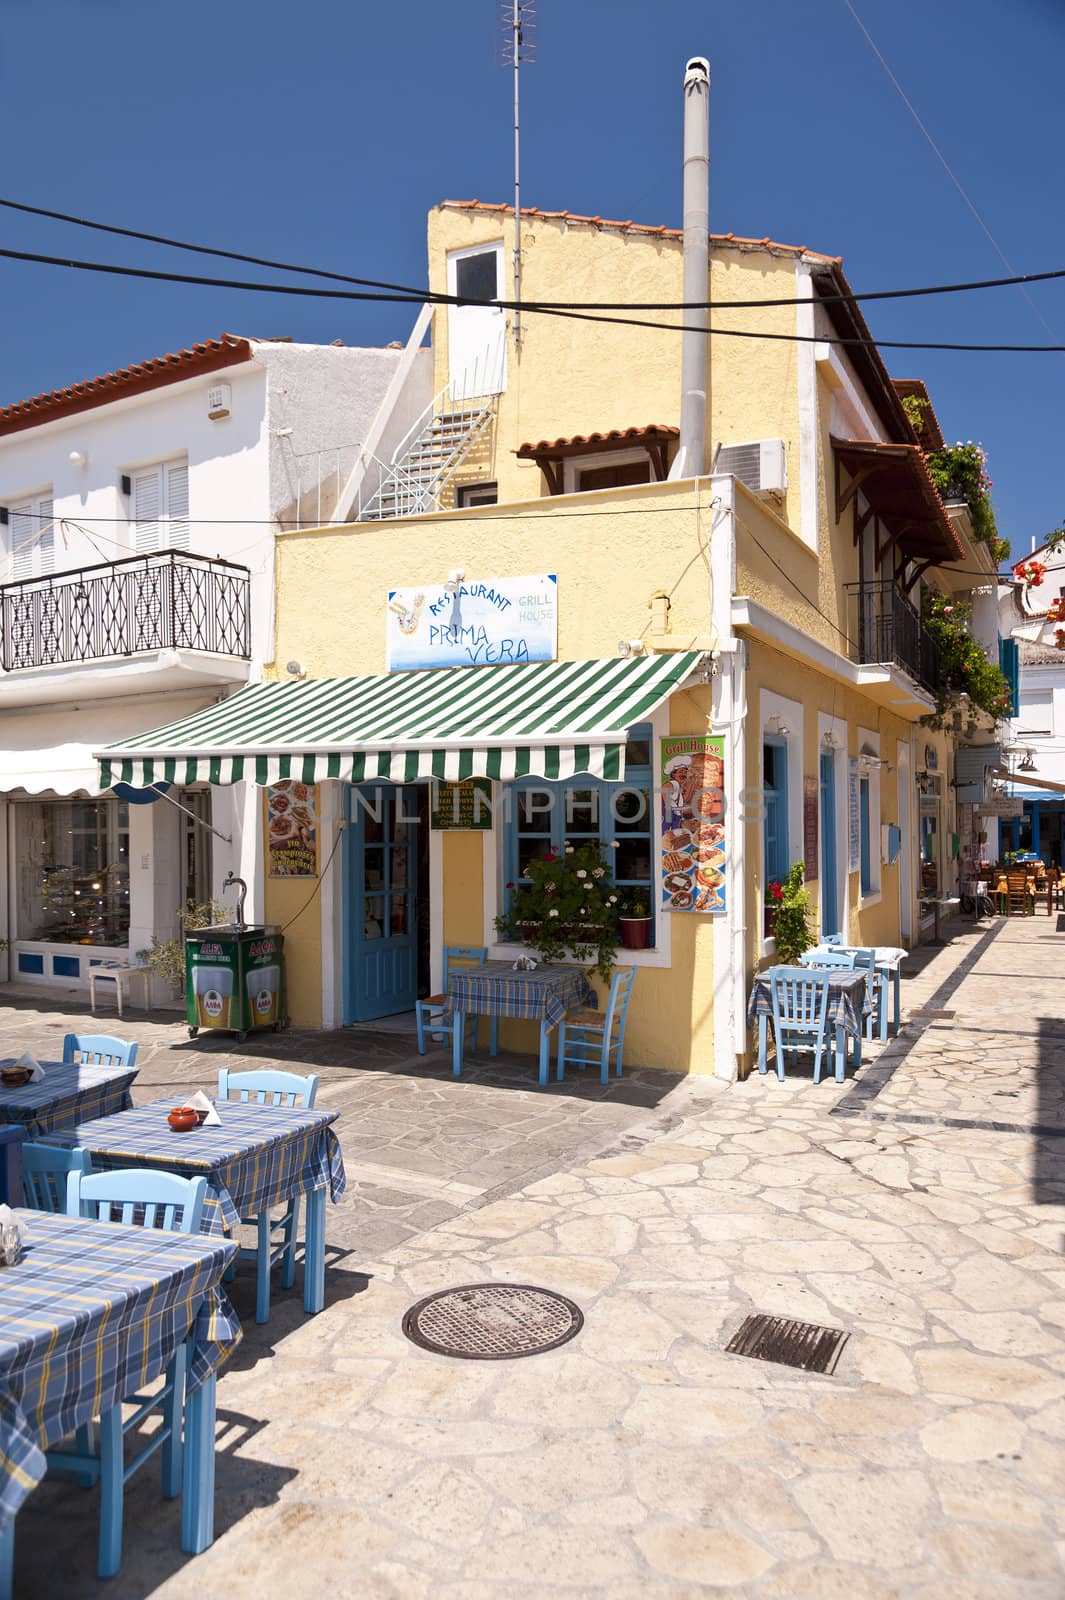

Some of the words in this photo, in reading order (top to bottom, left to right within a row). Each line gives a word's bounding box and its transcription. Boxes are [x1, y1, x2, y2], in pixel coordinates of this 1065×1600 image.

[519, 592, 552, 607] GRILL
[519, 608, 553, 622] HOUSE
[429, 623, 489, 647] PRIMA
[465, 638, 529, 664] VERA
[665, 740, 687, 756] Grill
[690, 739, 720, 754] House
[200, 943, 223, 955] ALFA
